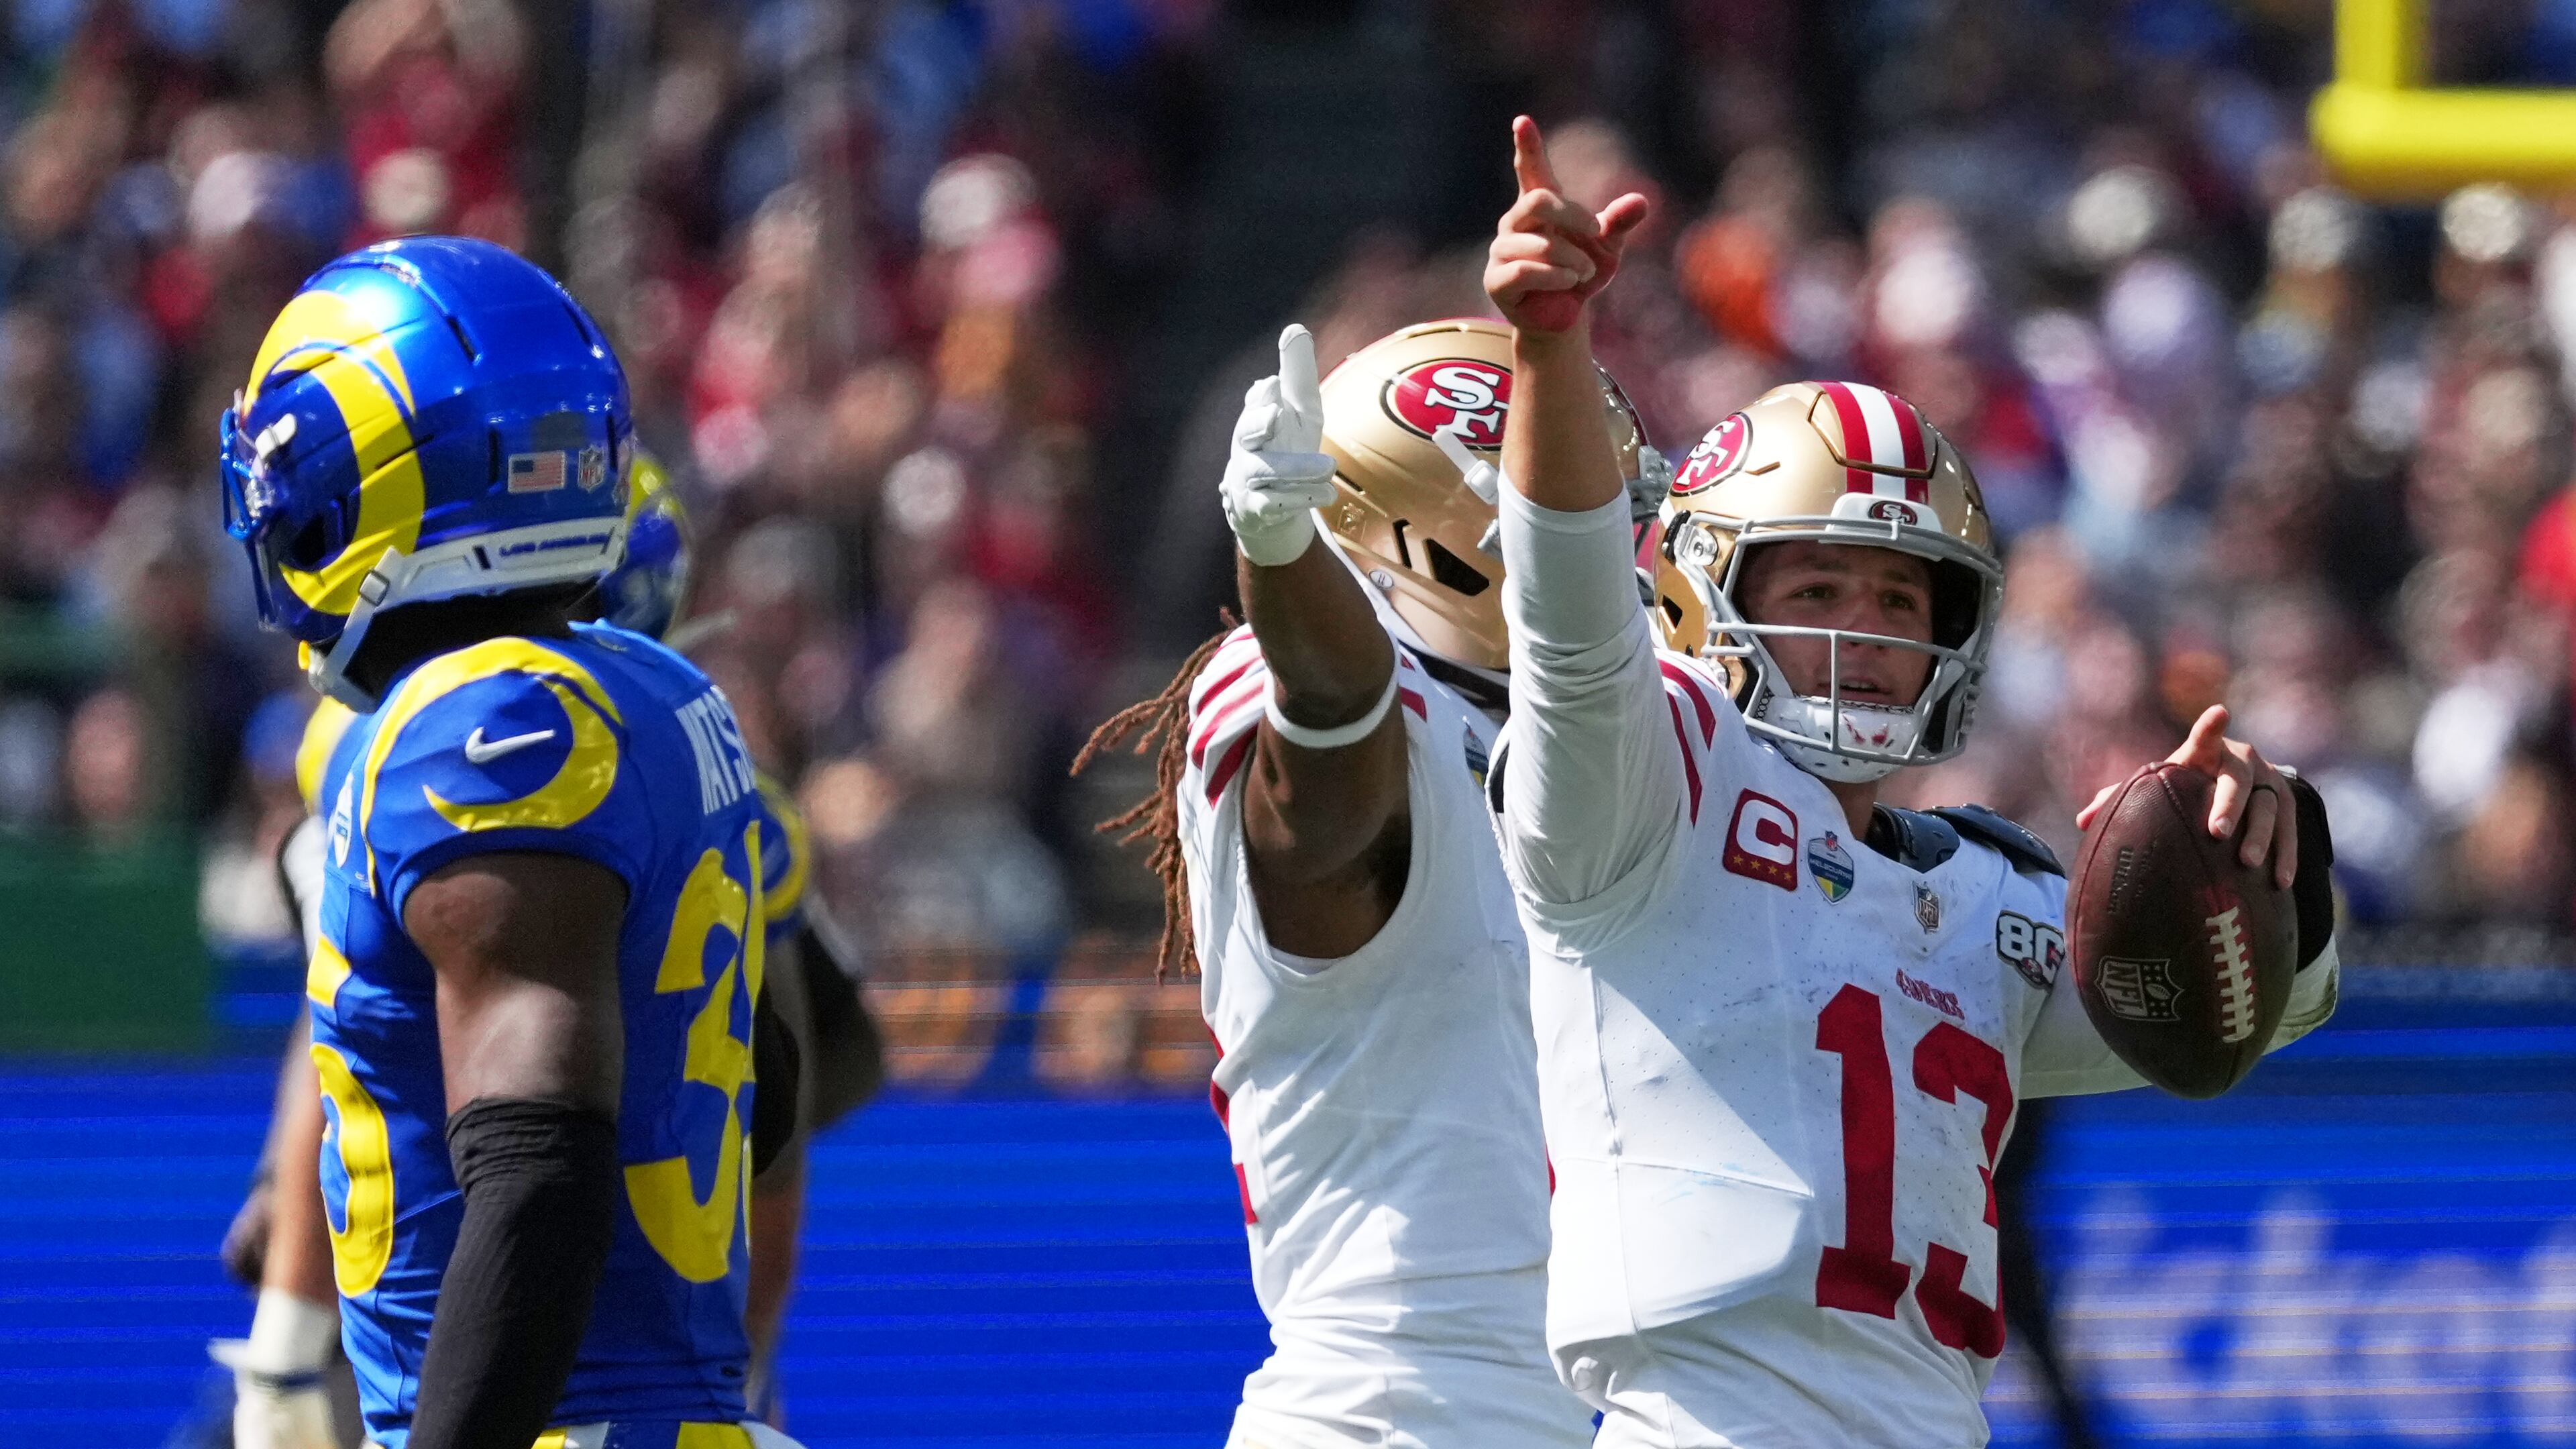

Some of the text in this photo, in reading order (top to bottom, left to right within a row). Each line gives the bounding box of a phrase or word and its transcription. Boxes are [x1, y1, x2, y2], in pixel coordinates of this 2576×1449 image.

[1424, 366, 1509, 439] SF
[1676, 421, 1736, 486] SF
[676, 684, 757, 816] WATS
[1736, 799, 1794, 866] C
[2105, 961, 2147, 1016] NFL
[625, 819, 765, 1283] 3
[1815, 983, 2013, 1359] 13
